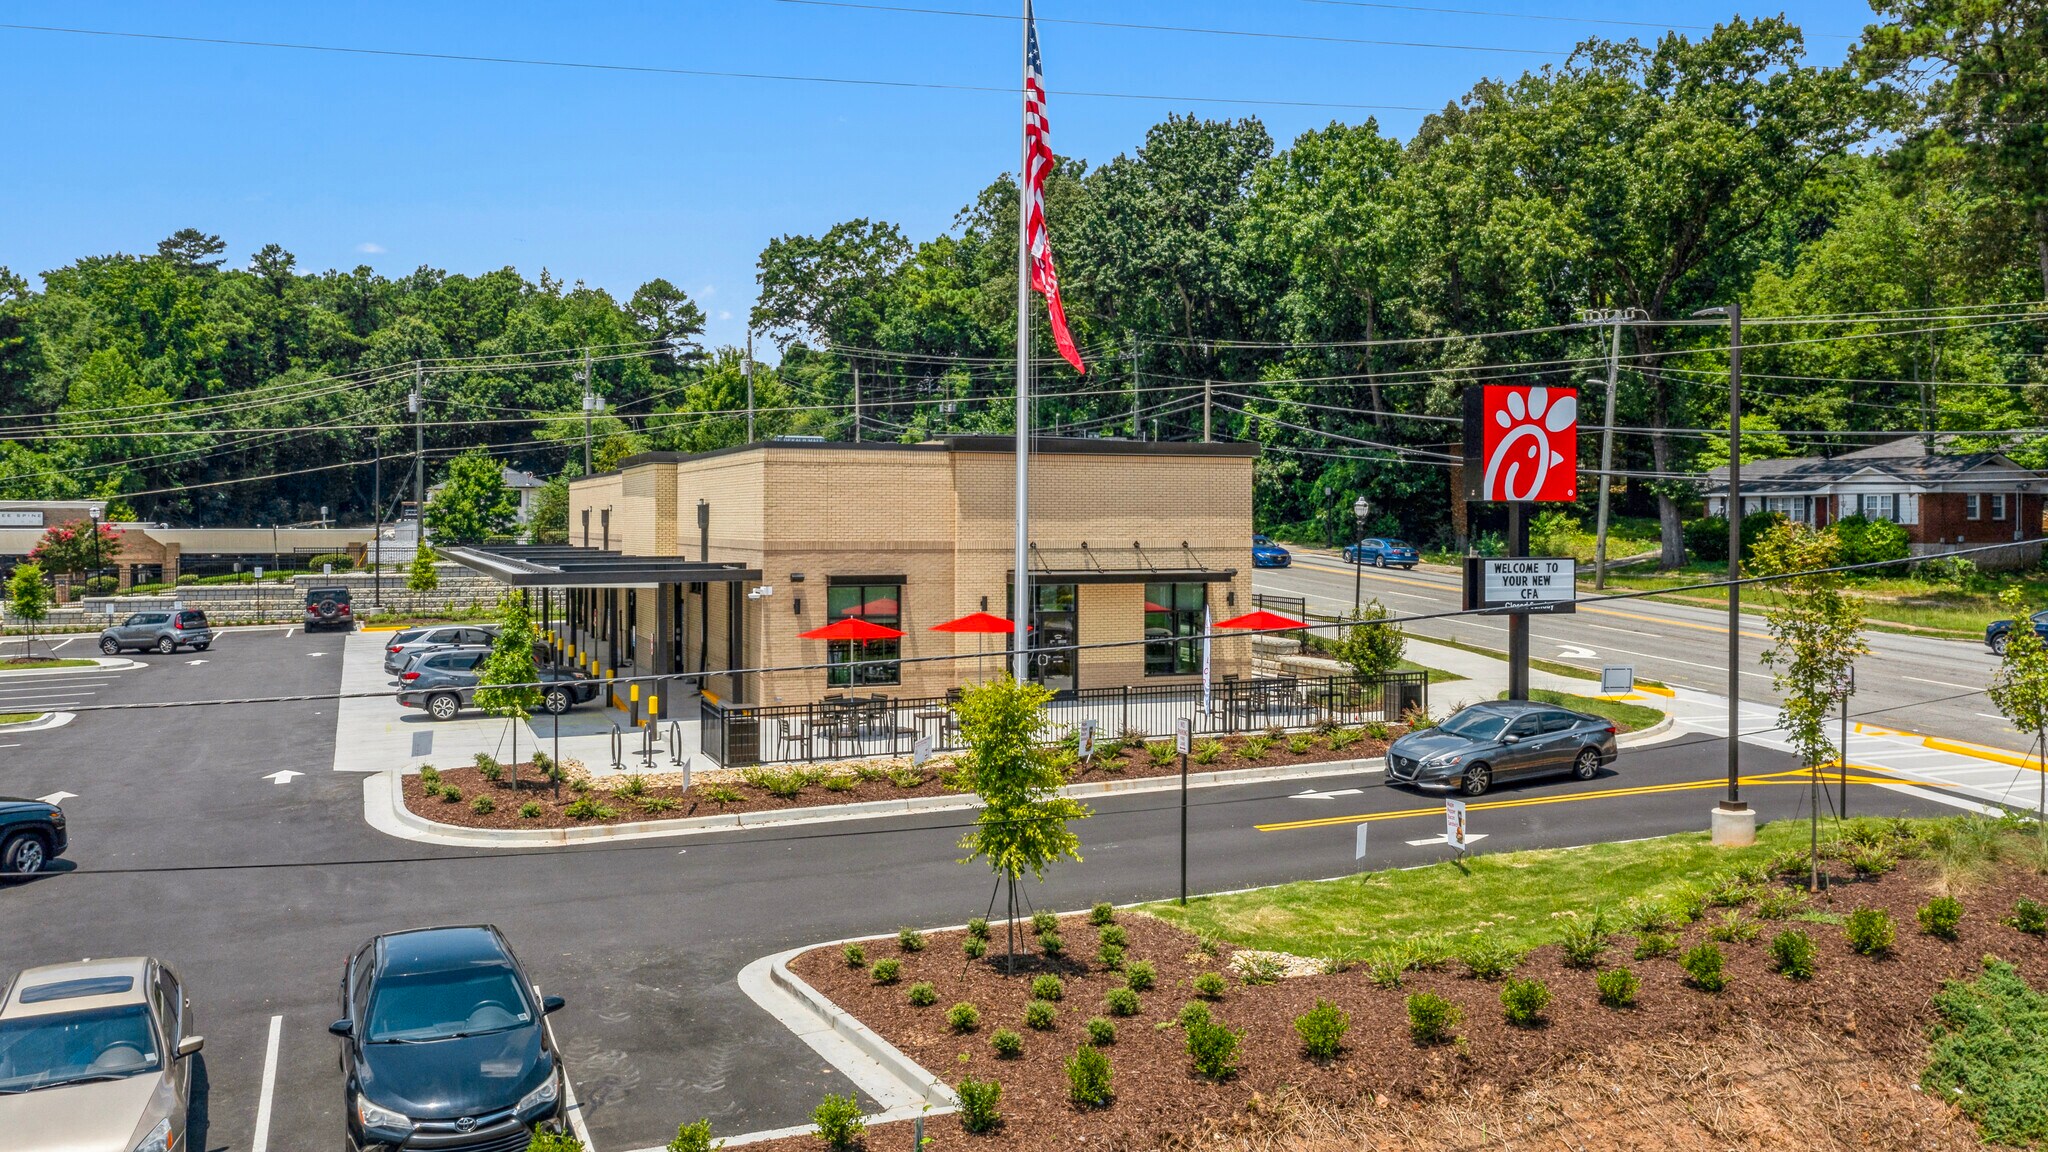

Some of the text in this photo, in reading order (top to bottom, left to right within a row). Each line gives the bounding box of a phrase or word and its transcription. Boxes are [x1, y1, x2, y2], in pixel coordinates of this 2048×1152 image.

[1494, 563, 1559, 573] WELCOME TO
[1502, 575, 1551, 587] YOUR NEW
[1520, 589, 1539, 599] CFA
